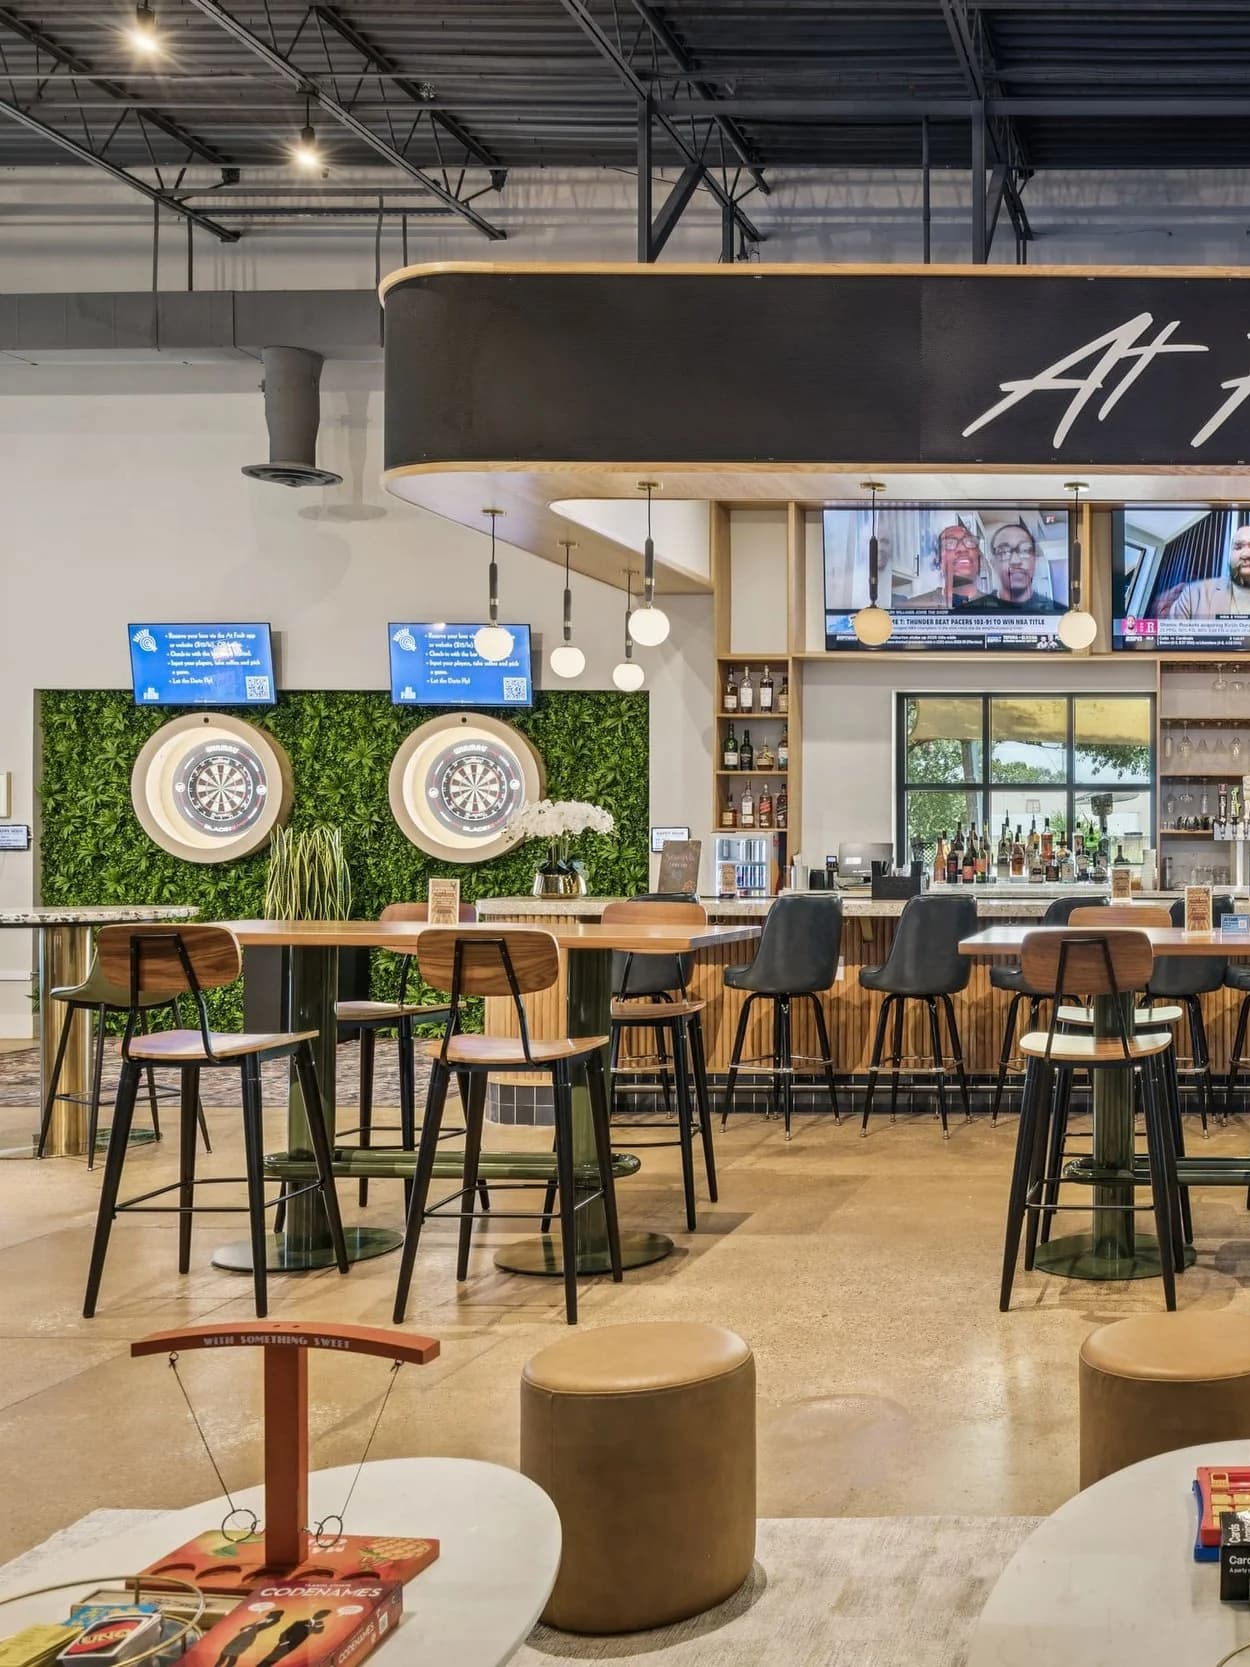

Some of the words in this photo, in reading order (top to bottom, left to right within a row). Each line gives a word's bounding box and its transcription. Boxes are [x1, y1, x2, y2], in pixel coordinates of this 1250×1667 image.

[962, 311, 1210, 449] At
[203, 1335, 235, 1346] WITH
[240, 1335, 308, 1346] SOMETHING
[313, 1336, 350, 1349] SWEET
[1228, 1523, 1241, 1543] Cards
[260, 1587, 383, 1598] CODENAMES
[80, 1628, 133, 1645] UNO
[338, 1622, 375, 1664] CODENAMES
